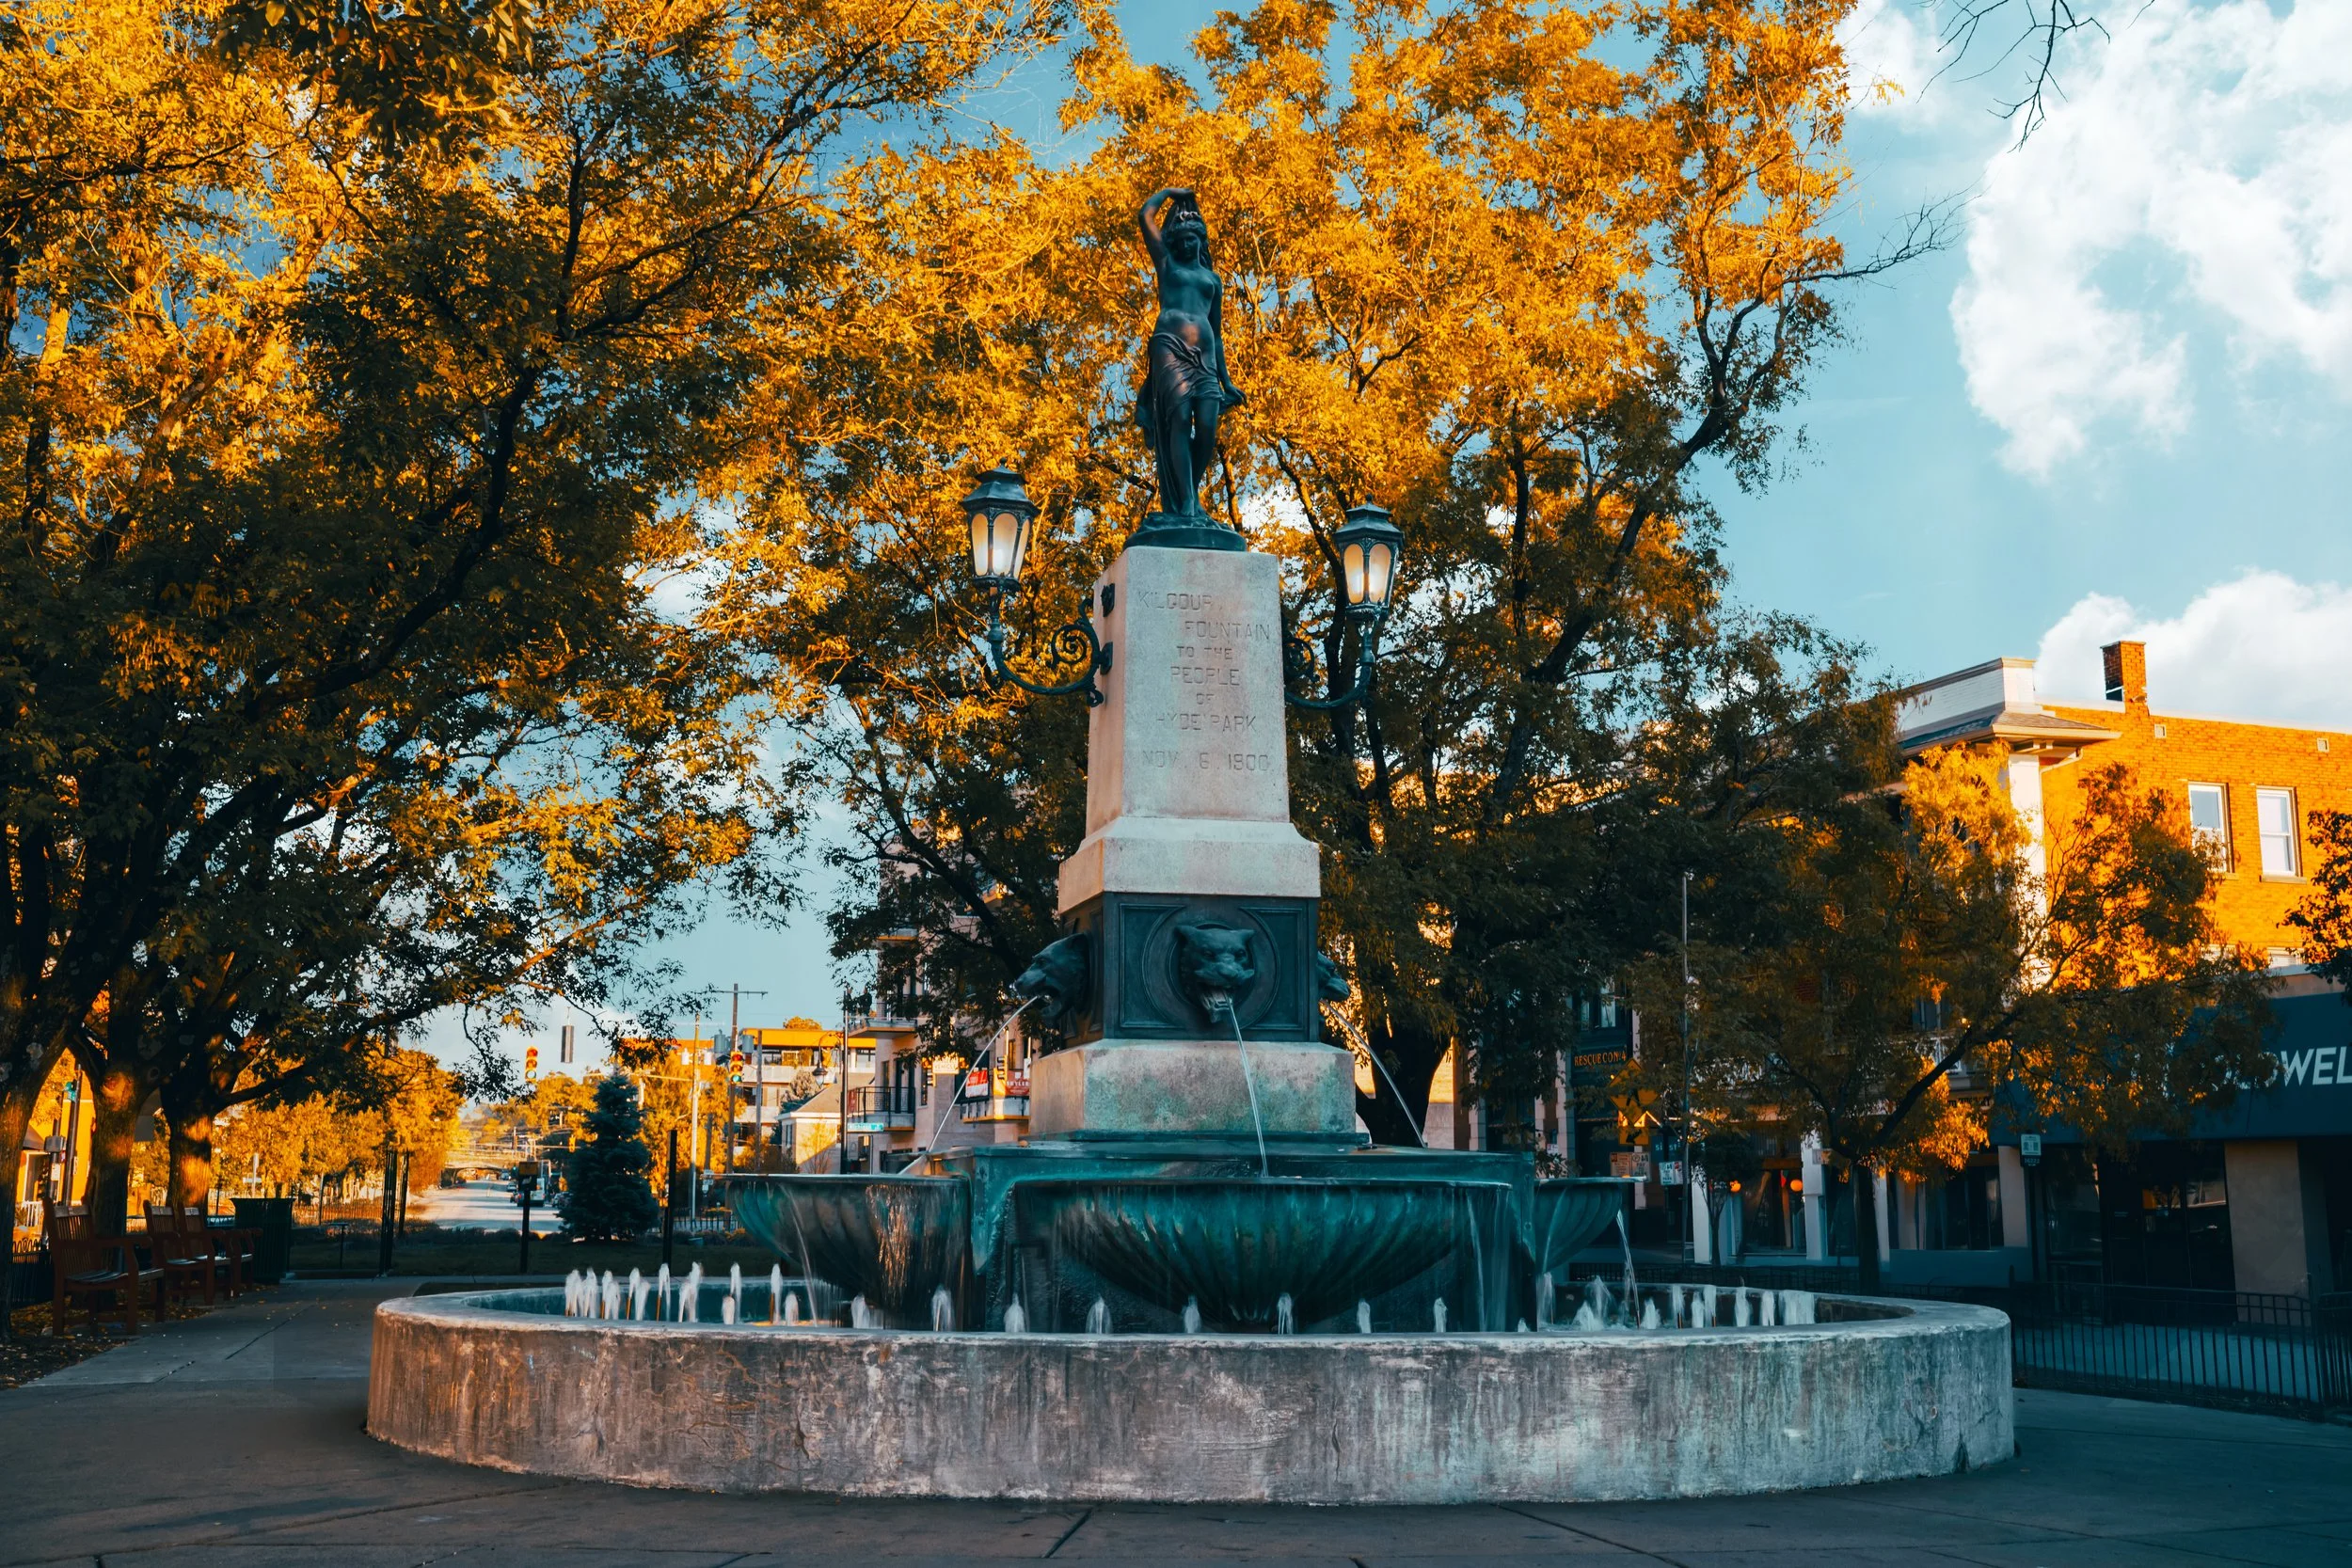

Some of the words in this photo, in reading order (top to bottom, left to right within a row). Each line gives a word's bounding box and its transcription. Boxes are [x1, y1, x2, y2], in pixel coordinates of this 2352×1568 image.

[1184, 621, 1270, 641] FOUNTAIN
[1176, 646, 1195, 658] TO
[1203, 647, 1233, 660] THE
[1170, 666, 1240, 686] PEOPLE
[1196, 693, 1215, 705] OF
[1155, 712, 1201, 731] HYDE
[1210, 714, 1256, 732] PARK
